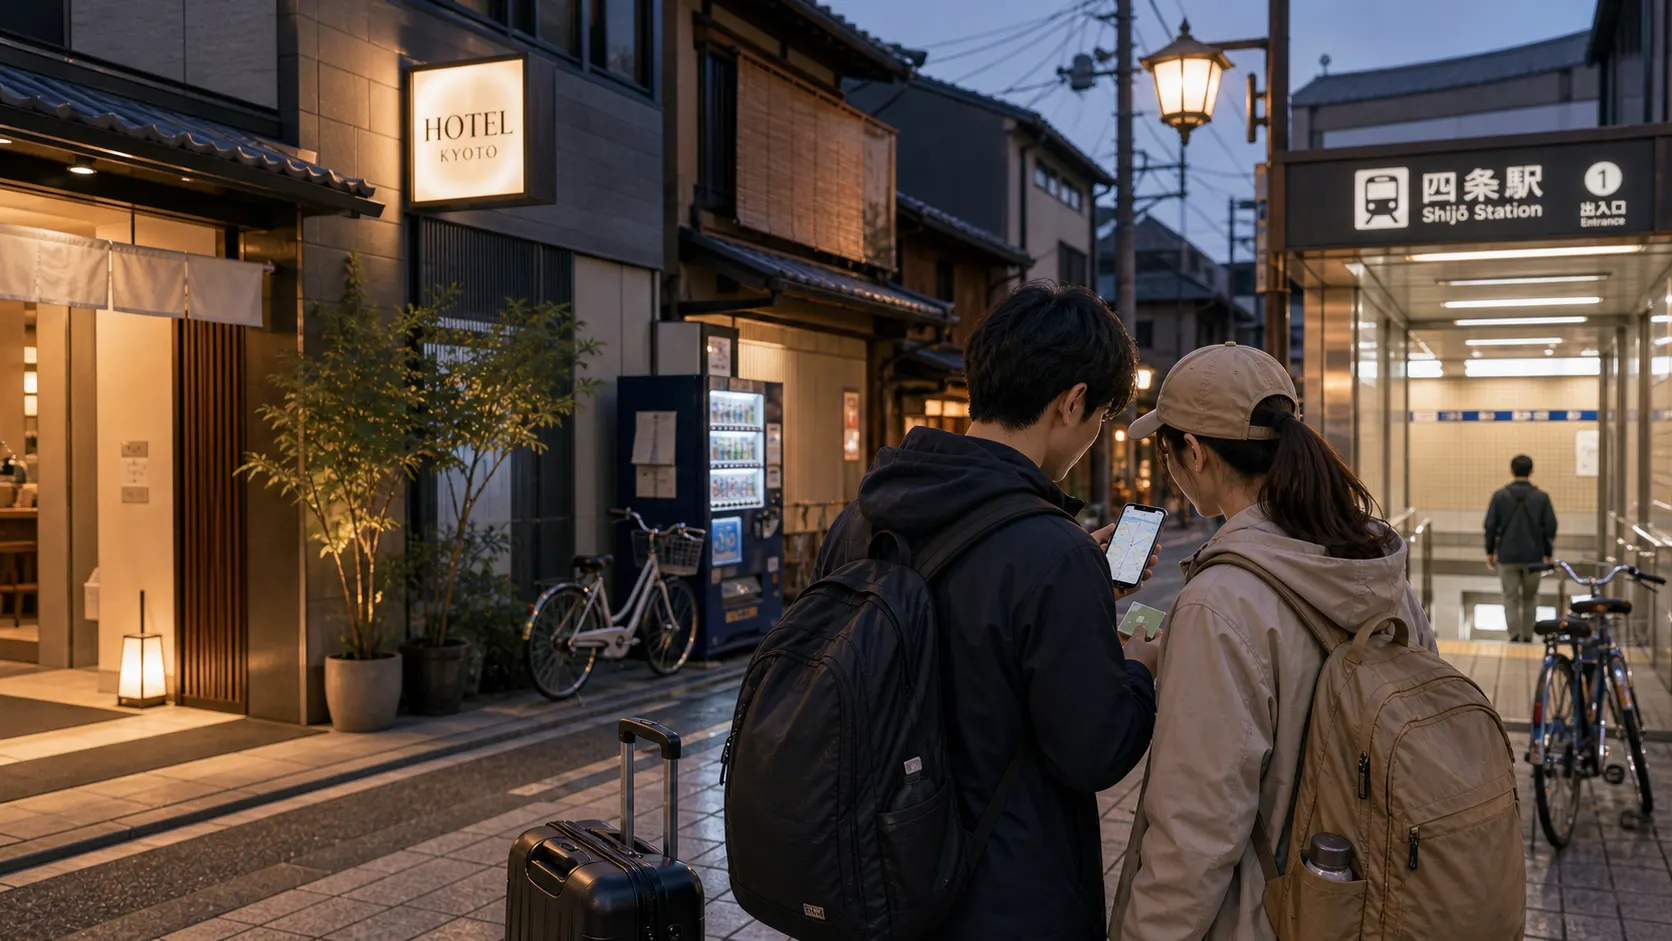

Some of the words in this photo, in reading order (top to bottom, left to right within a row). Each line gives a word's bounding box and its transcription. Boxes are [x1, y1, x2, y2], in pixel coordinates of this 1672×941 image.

[424, 110, 513, 142] HOTEL
[440, 145, 498, 163] KYOTO
[1422, 164, 1544, 204] 四条駅
[1597, 168, 1607, 190] 1
[1473, 202, 1543, 221] Station
[1580, 200, 1627, 217] 出入口
[1580, 217, 1626, 228] Entrance
